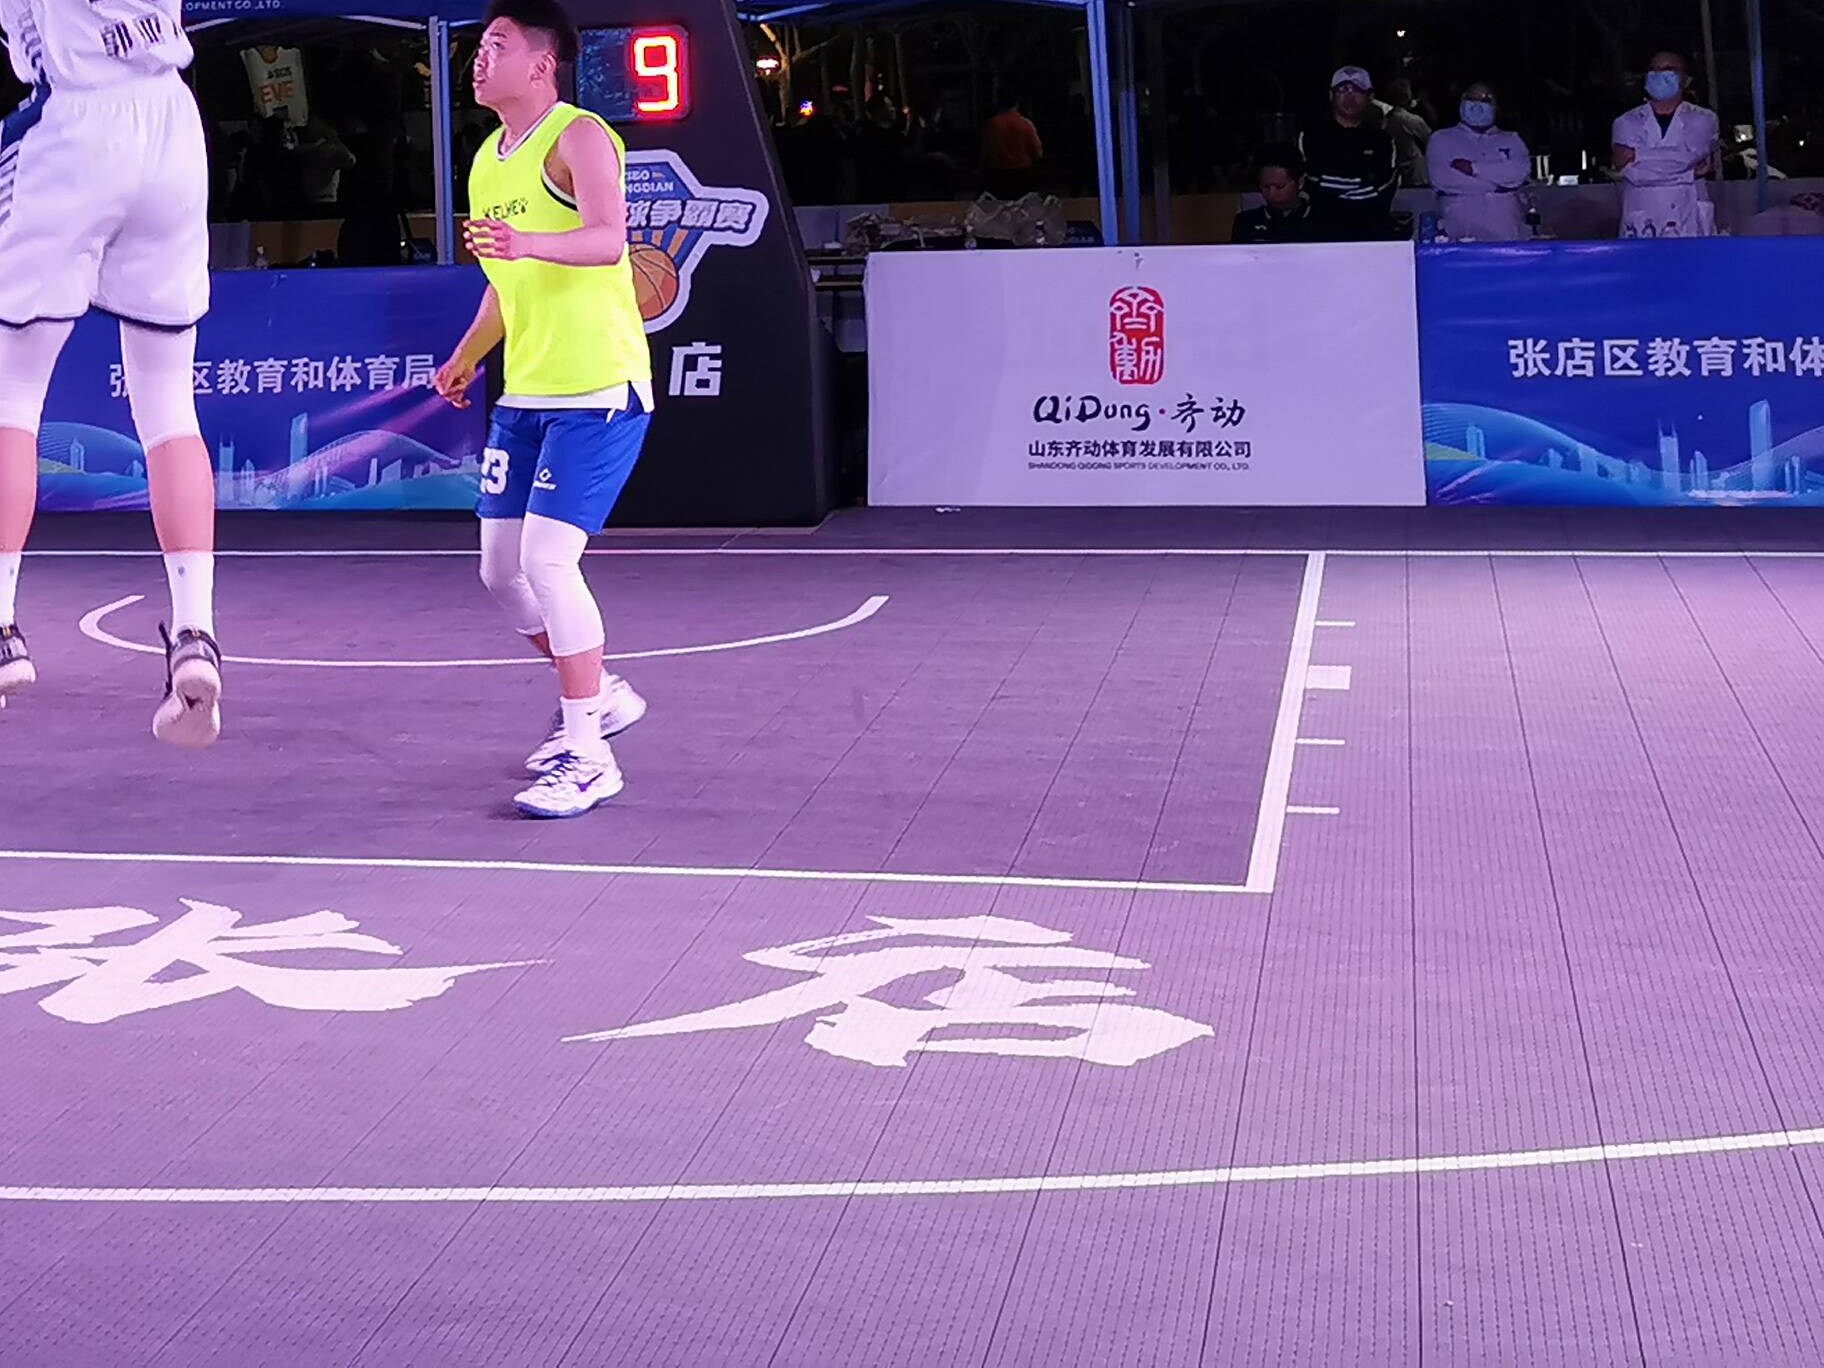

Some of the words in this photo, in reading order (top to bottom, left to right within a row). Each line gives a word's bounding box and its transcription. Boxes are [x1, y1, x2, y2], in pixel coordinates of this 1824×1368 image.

[632, 34, 679, 113] 9
[110, 354, 436, 397] 张区教育和体育局
[668, 341, 722, 397] 店
[1508, 327, 1824, 378] 张店区教育和体
[1028, 440, 1251, 458] 山东齐动体育发展有限公司
